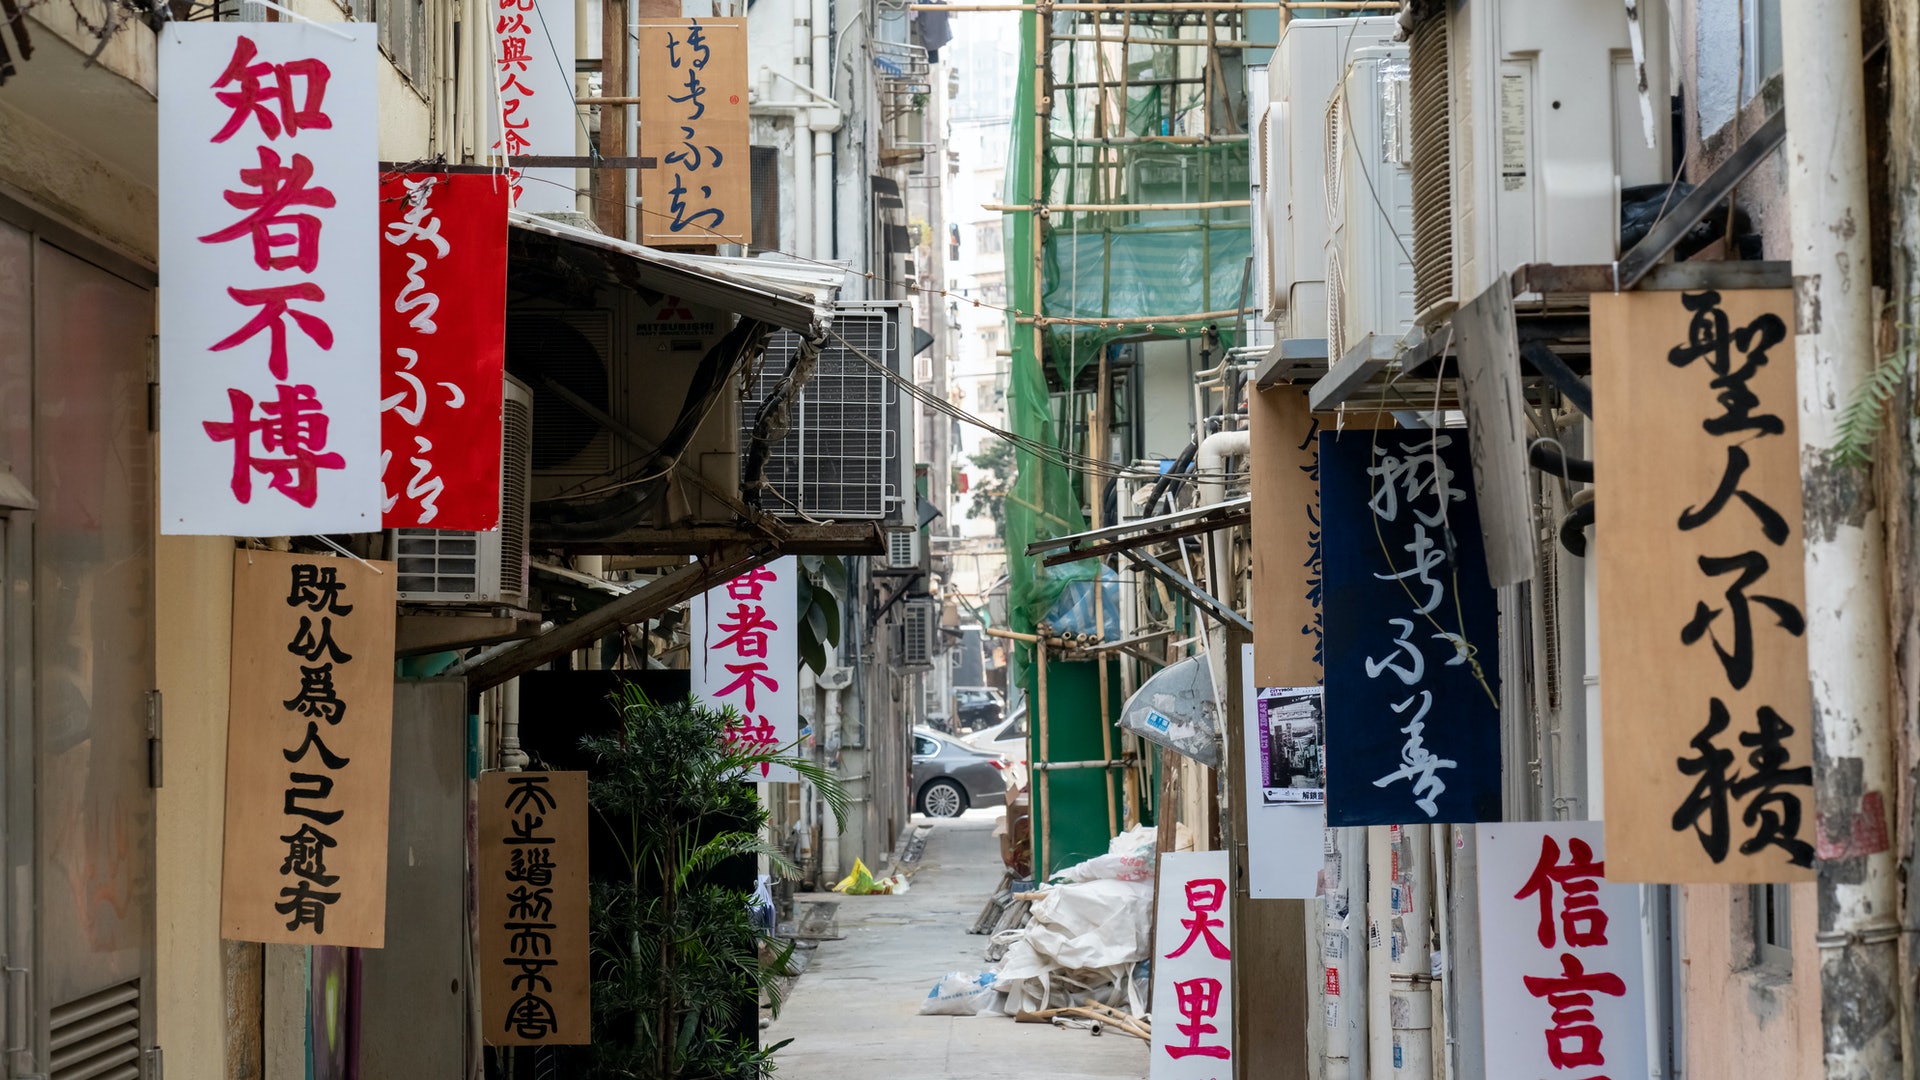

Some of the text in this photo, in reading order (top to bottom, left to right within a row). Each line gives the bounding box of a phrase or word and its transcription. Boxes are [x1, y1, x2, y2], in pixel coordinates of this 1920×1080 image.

[199, 36, 347, 508] 知者不博
[636, 322, 714, 331] MITSUBISHI
[1667, 290, 1814, 870] 聖人不積
[1260, 729, 1269, 749] CITY
[1261, 752, 1270, 786] CONNECT
[1514, 835, 1626, 1080] 信言
